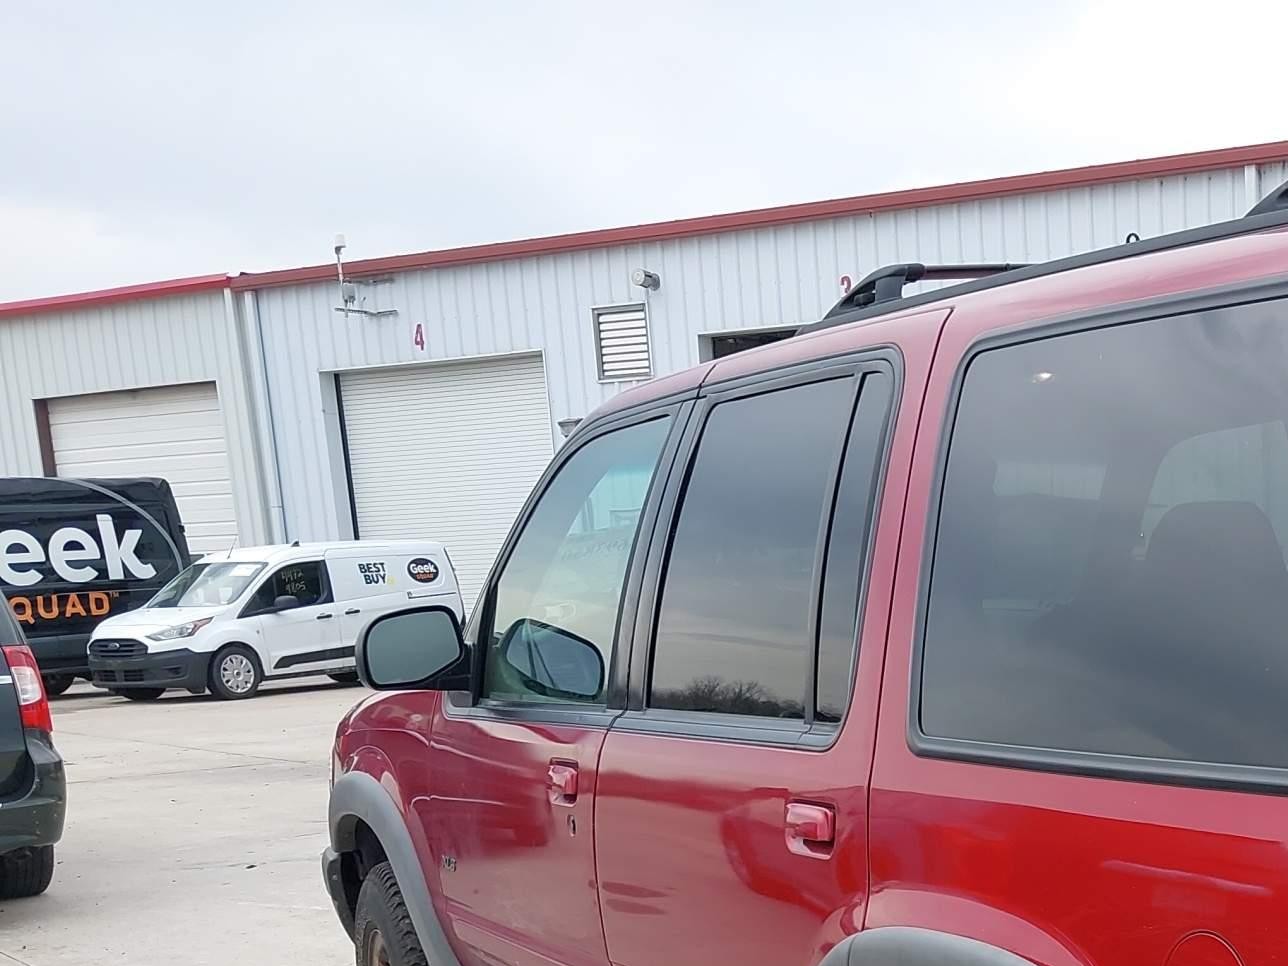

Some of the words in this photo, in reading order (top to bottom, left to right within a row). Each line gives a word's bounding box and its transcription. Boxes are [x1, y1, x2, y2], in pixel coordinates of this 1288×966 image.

[414, 323, 425, 351] 4
[358, 562, 386, 574] BEST
[409, 562, 437, 574] Geek
[363, 573, 387, 585] BUY
